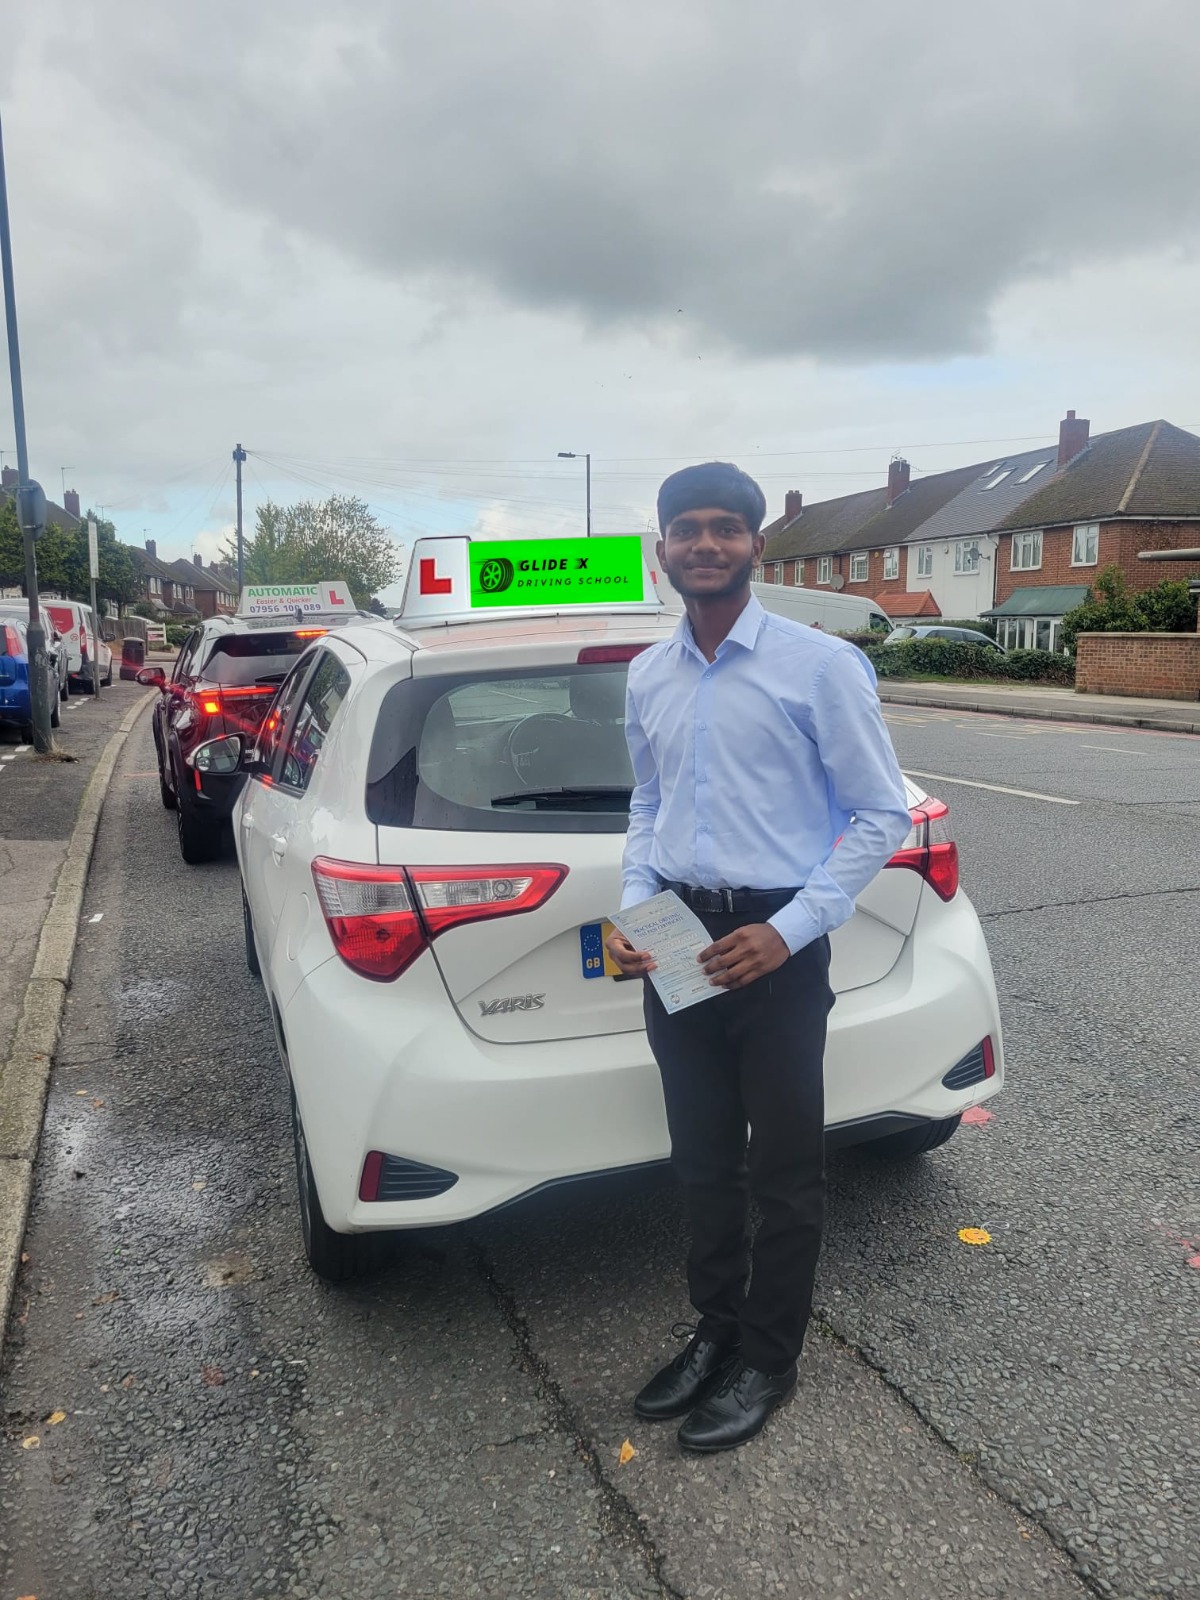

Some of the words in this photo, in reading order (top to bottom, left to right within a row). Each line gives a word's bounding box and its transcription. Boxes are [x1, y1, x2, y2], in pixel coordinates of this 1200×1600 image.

[518, 558, 568, 572] GLIDE
[576, 557, 589, 570] X
[420, 559, 452, 595] L
[517, 577, 572, 588] DRIVING
[578, 575, 629, 586] SCHOOL
[248, 586, 317, 597] AUTOMATIC
[329, 590, 344, 605] L
[256, 597, 276, 605] Easier
[249, 605, 279, 613] 07956
[303, 603, 321, 611] 089
[586, 957, 601, 969] GB
[478, 993, 546, 1016] YARIS
